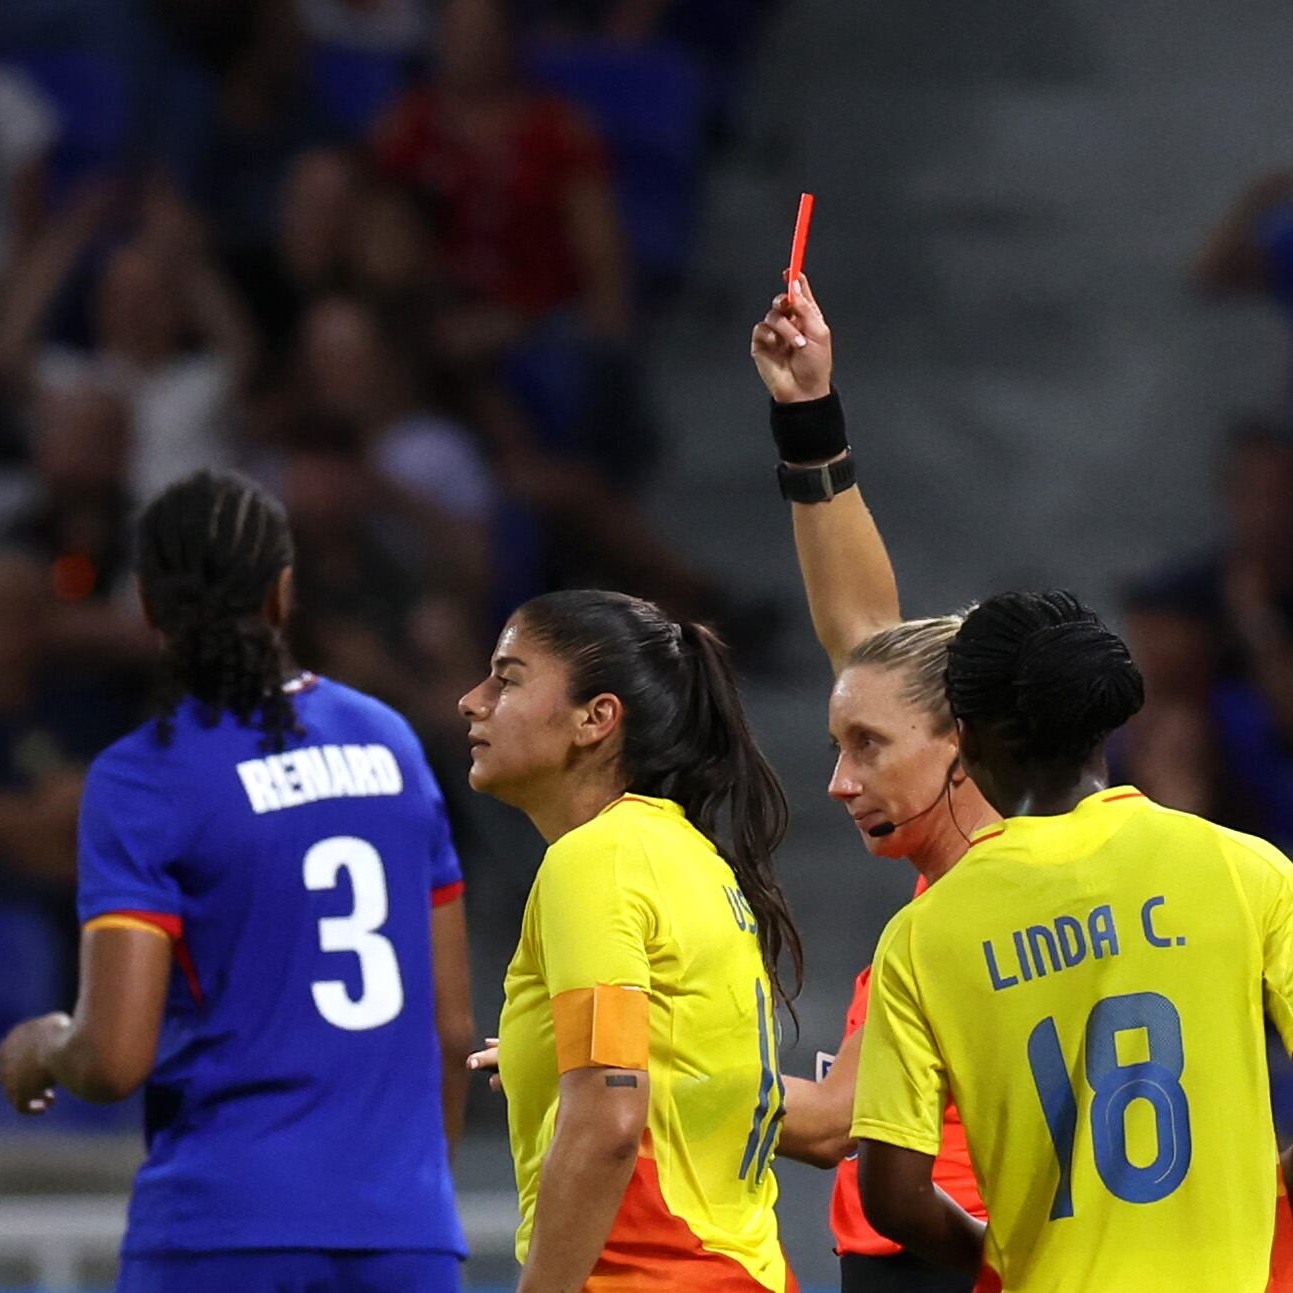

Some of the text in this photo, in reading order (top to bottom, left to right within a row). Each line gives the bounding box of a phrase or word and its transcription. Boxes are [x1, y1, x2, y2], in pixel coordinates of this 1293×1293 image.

[236, 744, 404, 814] RENARD
[302, 835, 405, 1031] 3
[982, 896, 1186, 991] LINDA C.
[1027, 991, 1192, 1221] 18
